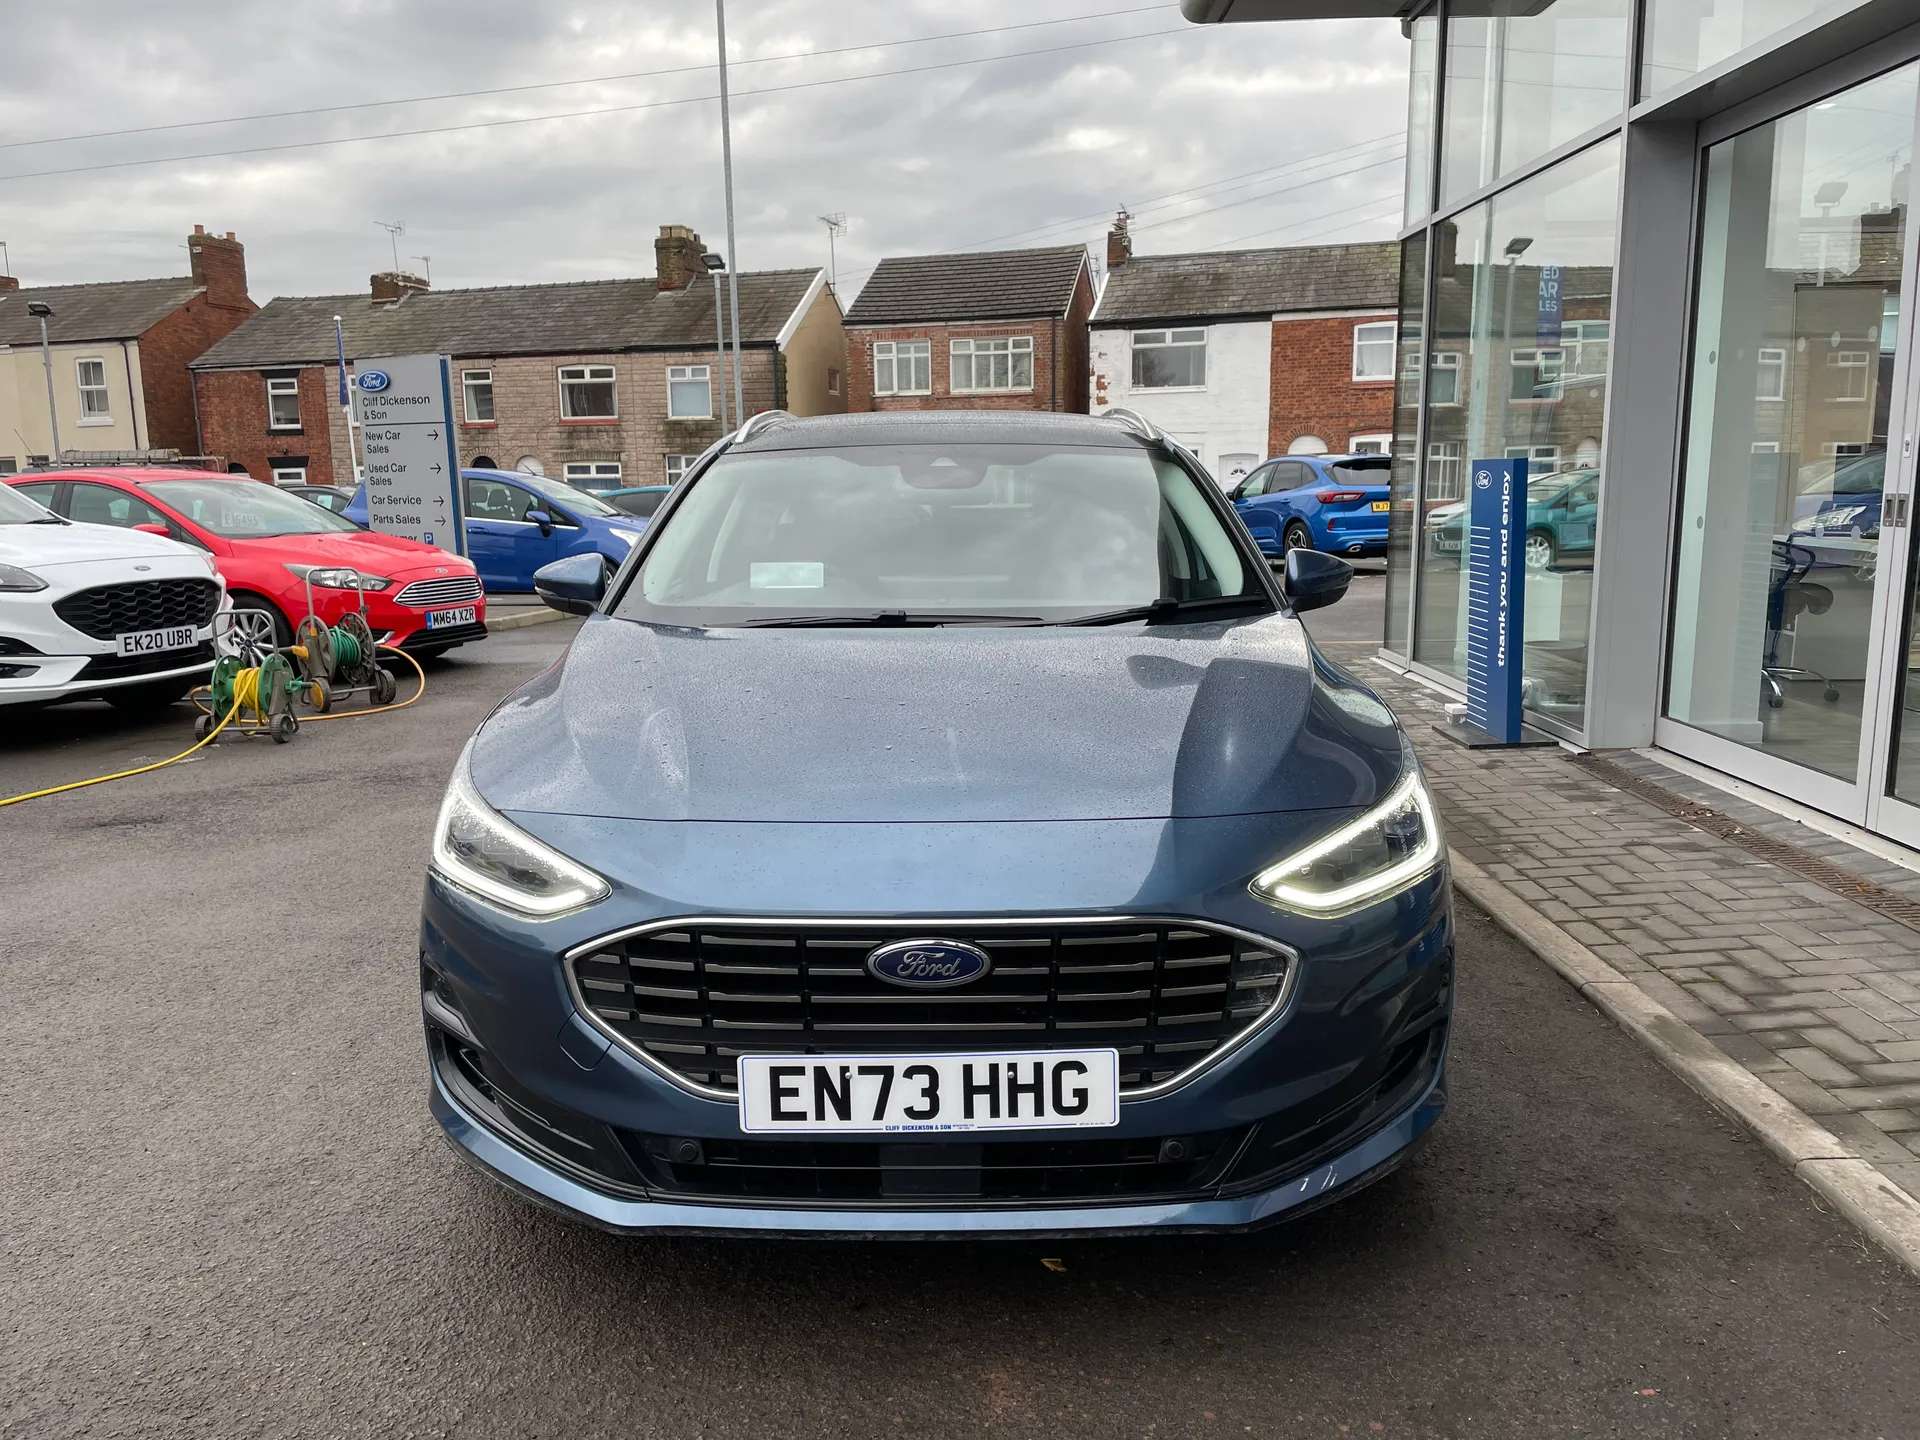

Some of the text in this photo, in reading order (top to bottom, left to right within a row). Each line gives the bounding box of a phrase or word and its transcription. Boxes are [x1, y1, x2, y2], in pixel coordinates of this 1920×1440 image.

[363, 374, 382, 388] Ford
[362, 395, 431, 407] Cliff Dickenson
[363, 410, 388, 420] & Son
[365, 430, 401, 440] New Car
[367, 444, 389, 454] Sales
[368, 463, 407, 473] Used Car
[370, 476, 392, 486] Sales
[371, 495, 422, 505] Car Service
[1501, 470, 1511, 526] enjoy
[373, 514, 421, 525] Parts Sales
[1499, 572, 1508, 608] you
[432, 608, 474, 626] MM64 XZR
[124, 629, 193, 653] EK20 UBR
[1498, 610, 1506, 667] thank
[897, 950, 961, 977] Ford
[769, 1060, 1089, 1121] EN73 HHG
